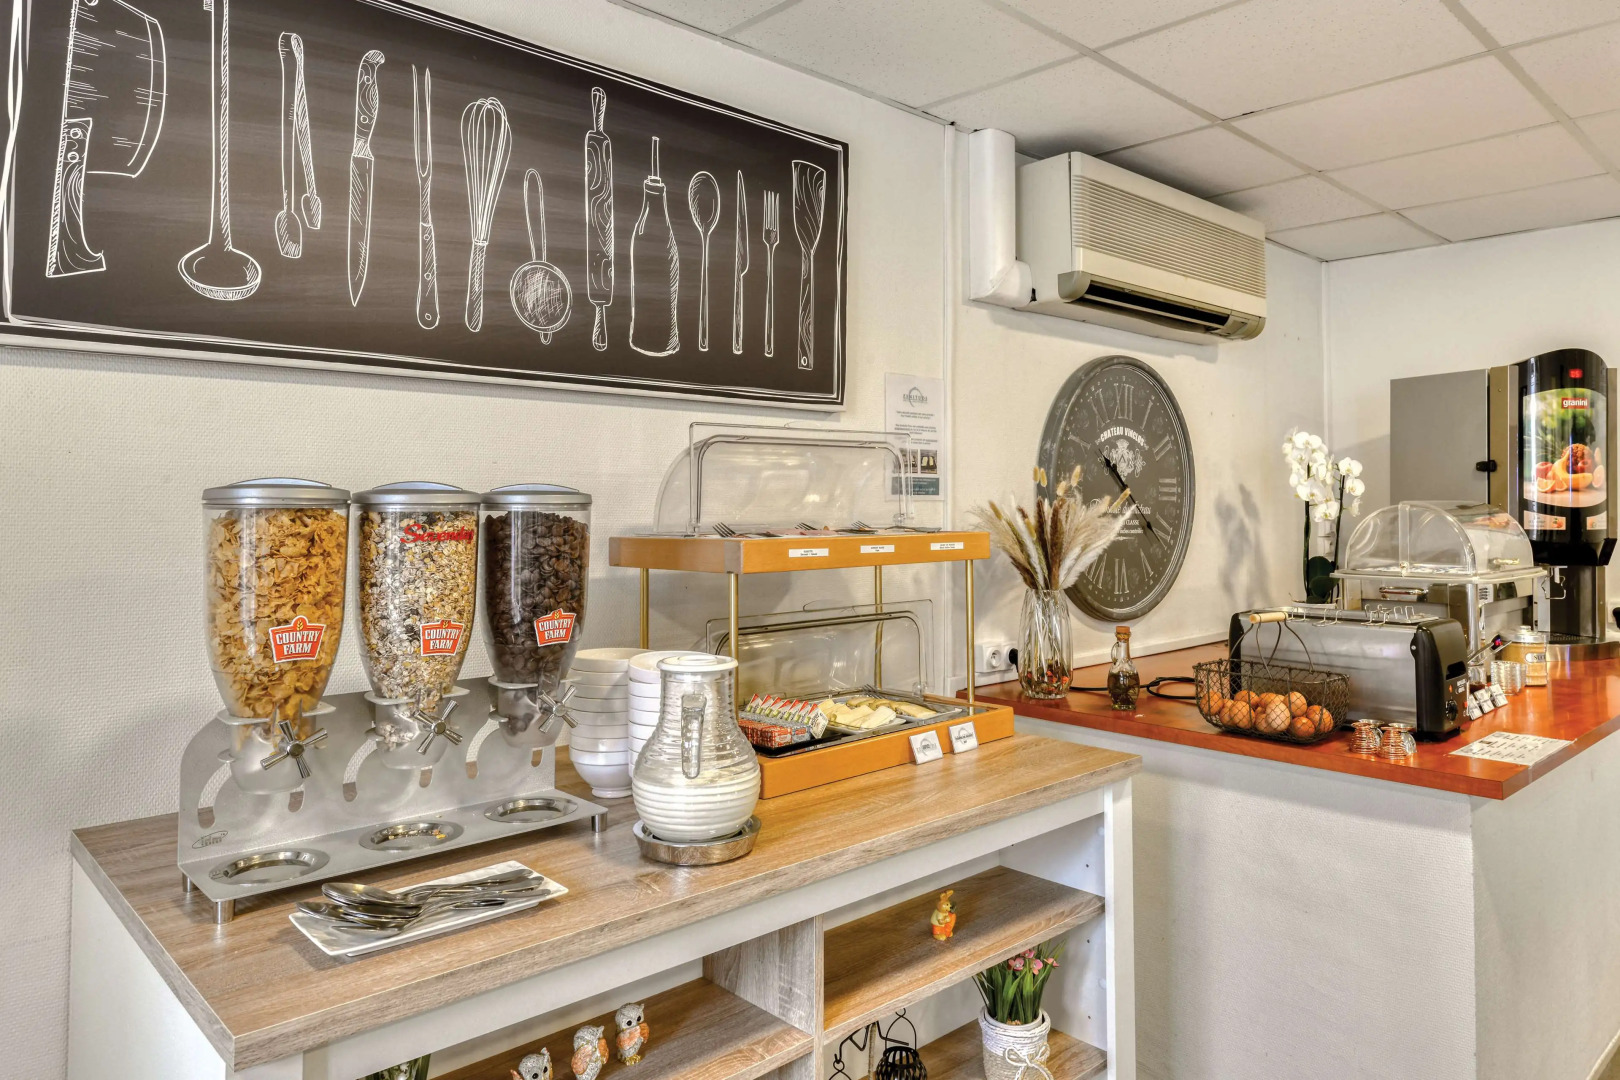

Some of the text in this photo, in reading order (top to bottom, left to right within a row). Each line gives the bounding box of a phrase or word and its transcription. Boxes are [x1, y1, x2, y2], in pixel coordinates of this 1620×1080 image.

[1563, 399, 1588, 408] granini
[1100, 426, 1124, 442] CHATEAU
[539, 618, 573, 632] COUNTRY
[275, 630, 320, 645] COUNTRY
[425, 628, 460, 640] COUNTRY
[545, 629, 567, 640] FARM
[283, 642, 312, 655] FARM
[430, 638, 453, 650] FARM
